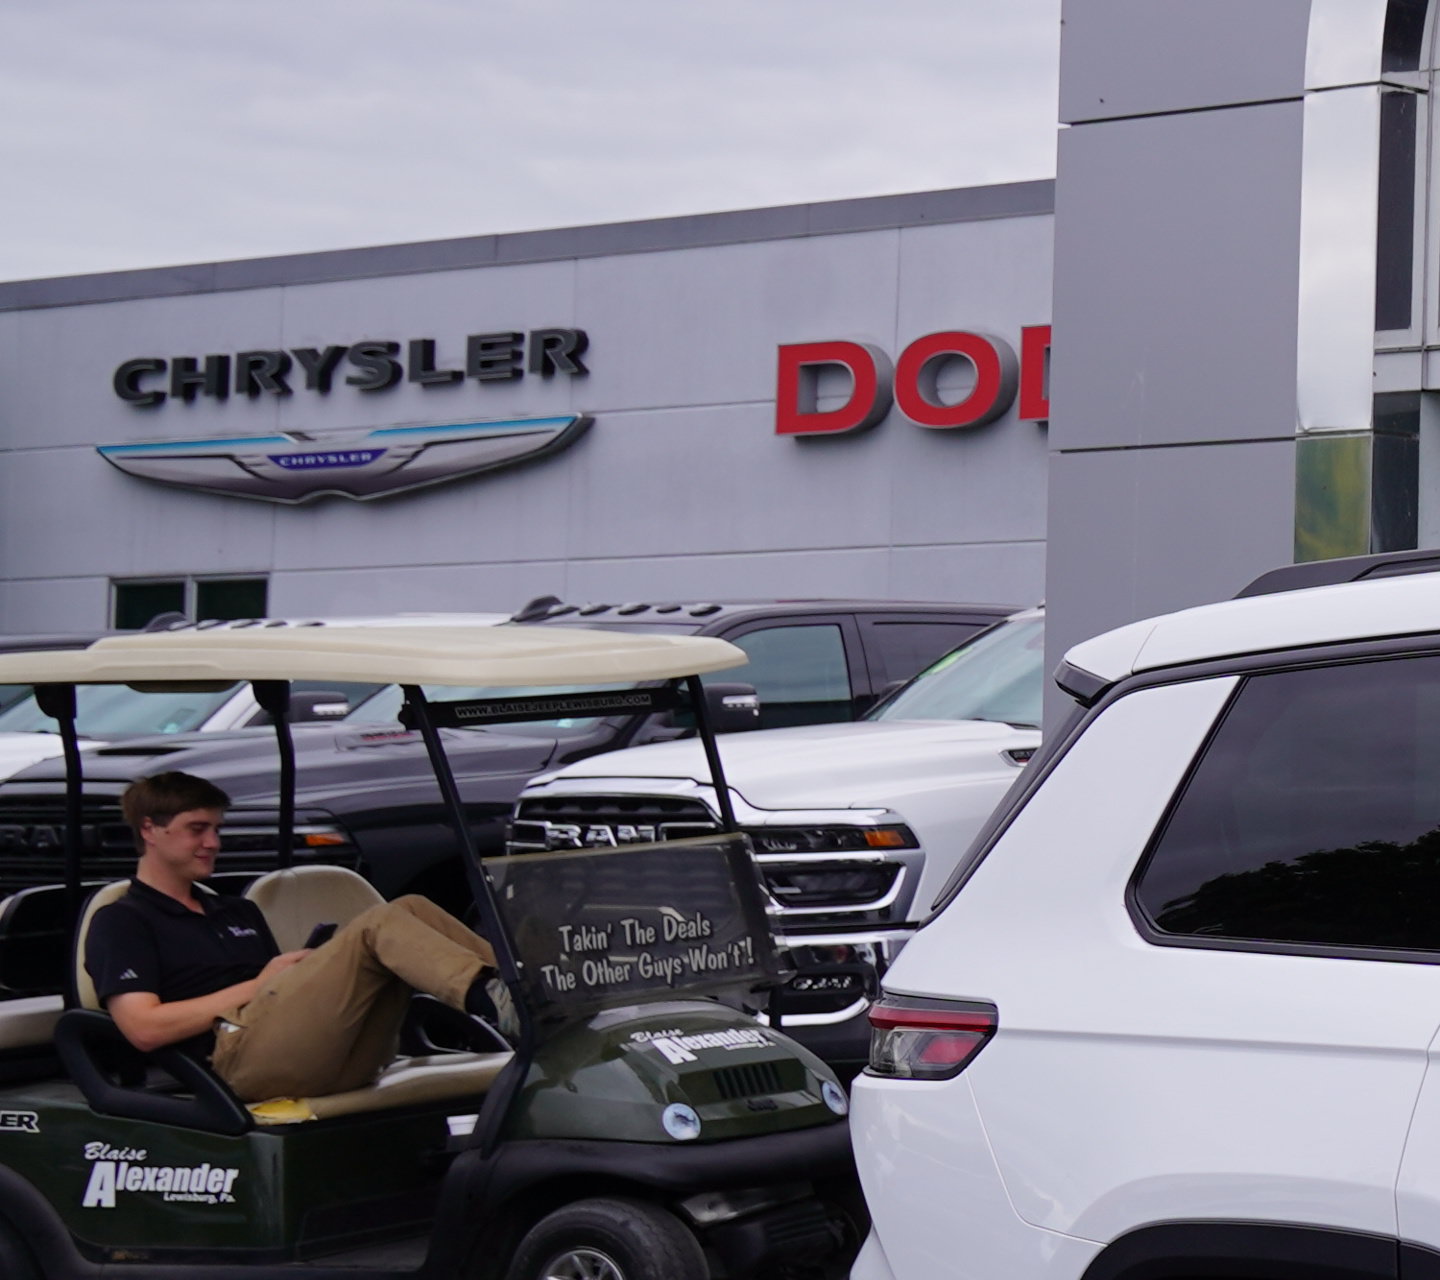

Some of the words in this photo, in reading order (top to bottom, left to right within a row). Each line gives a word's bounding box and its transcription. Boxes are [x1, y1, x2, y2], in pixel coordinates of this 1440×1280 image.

[114, 329, 590, 406] CHRYSLER
[279, 452, 374, 467] CHRYSLER
[546, 824, 656, 849] RAM
[558, 924, 612, 953] Takin'
[621, 919, 656, 947] The
[663, 912, 711, 941] Deals
[541, 965, 577, 991] The
[582, 959, 631, 986] Other
[638, 953, 683, 985] Guys
[652, 1029, 768, 1064] Alexander
[84, 1141, 147, 1161] Blaise
[82, 1161, 239, 1208] Alexander
